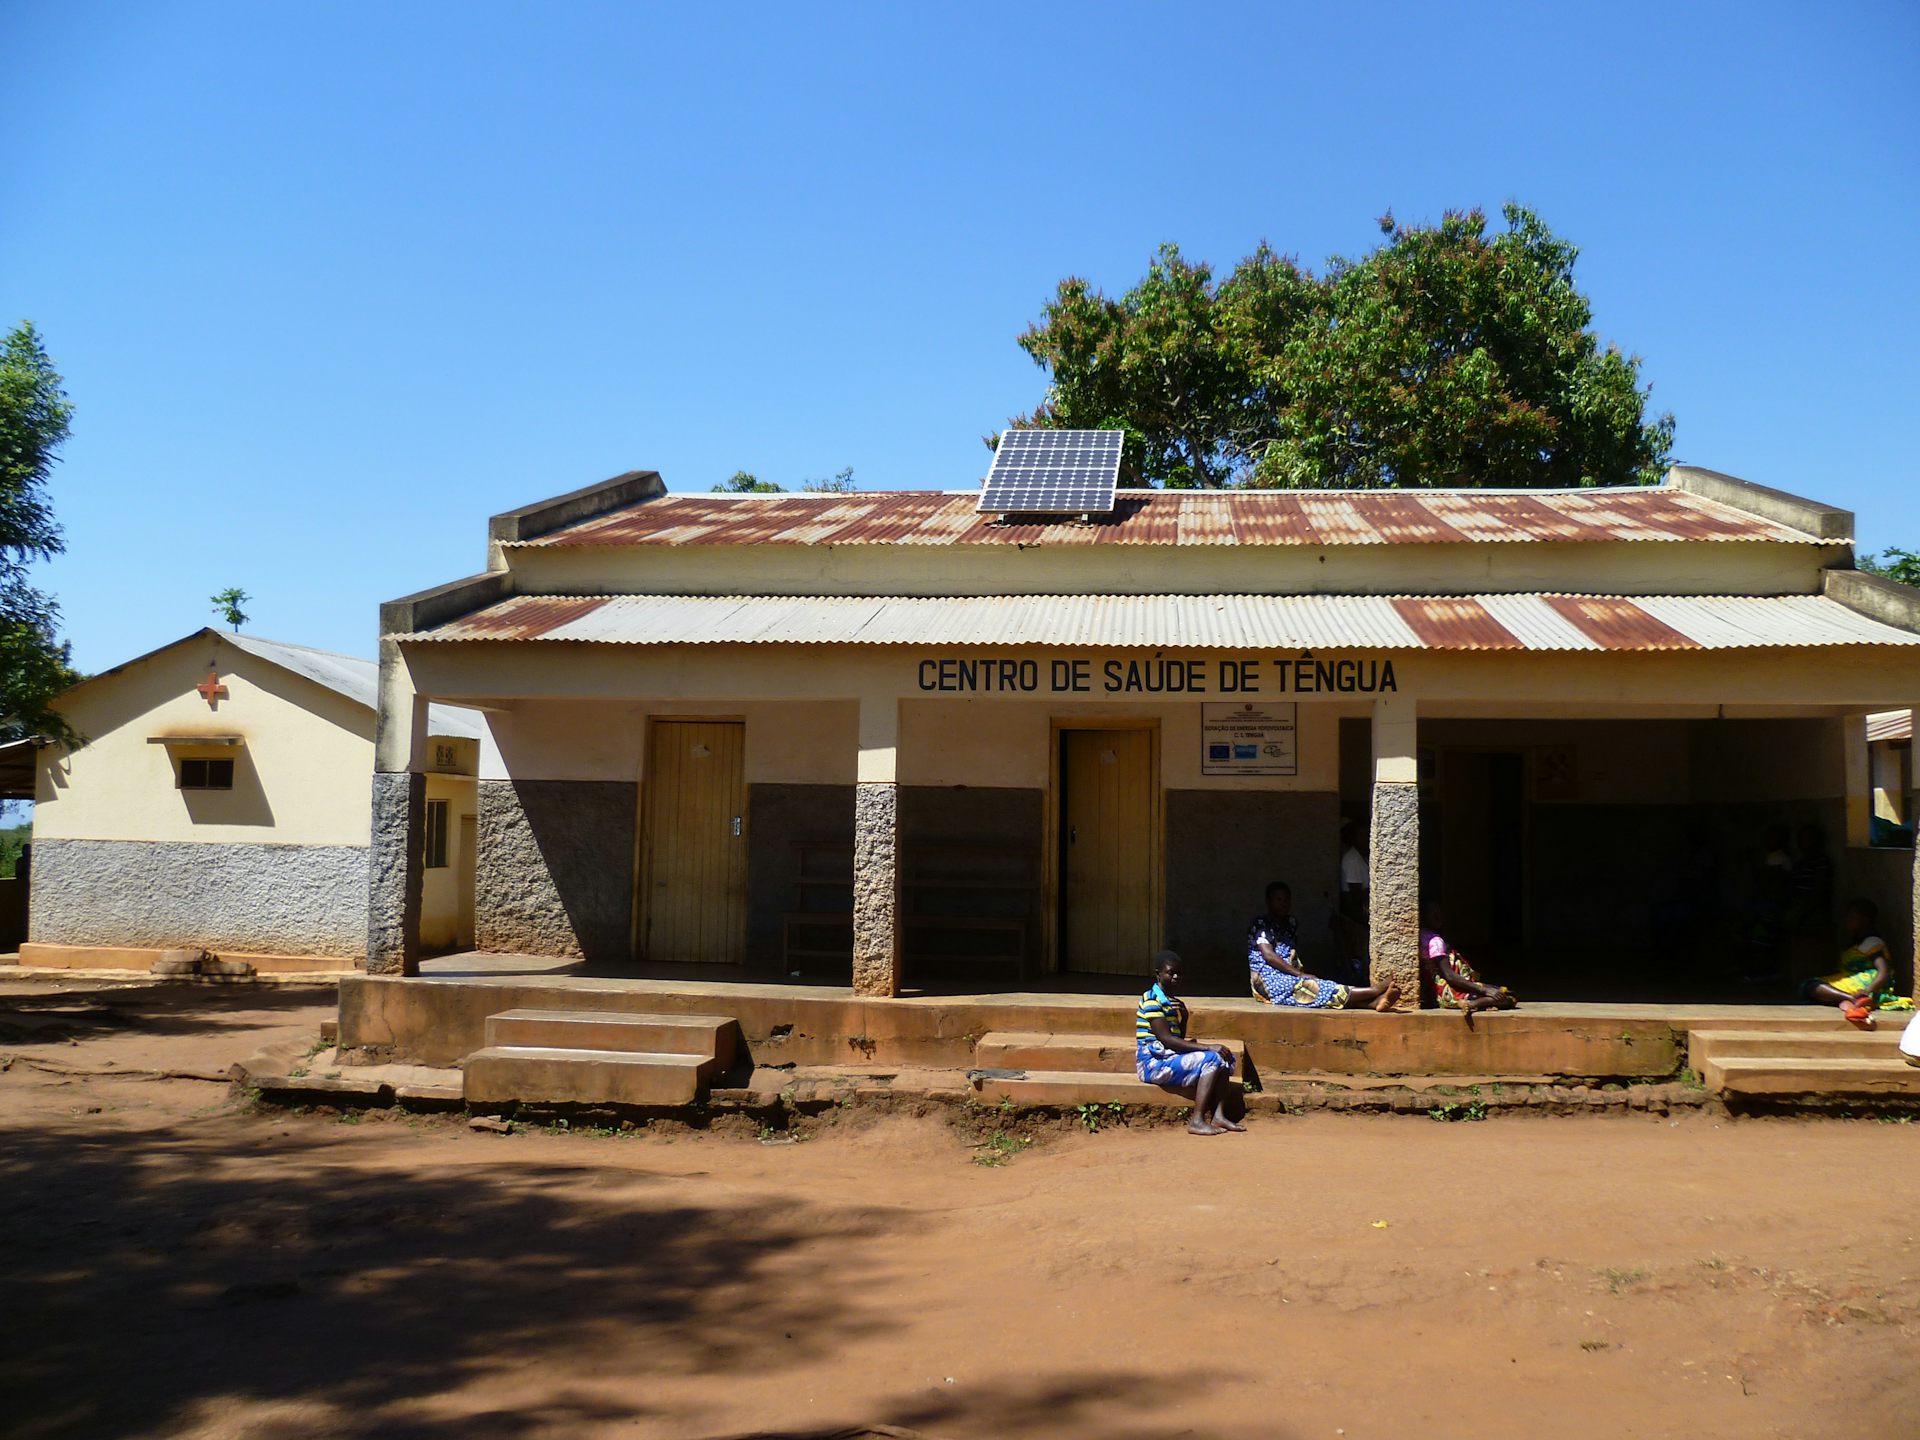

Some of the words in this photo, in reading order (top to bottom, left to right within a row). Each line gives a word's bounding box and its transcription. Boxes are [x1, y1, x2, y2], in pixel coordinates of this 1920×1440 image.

[918, 659, 1038, 692] CENTRO
[1051, 659, 1091, 692] DE
[1103, 650, 1206, 693] SAÚDE
[1219, 660, 1260, 693] DE
[1273, 649, 1399, 693] TÊNGUA
